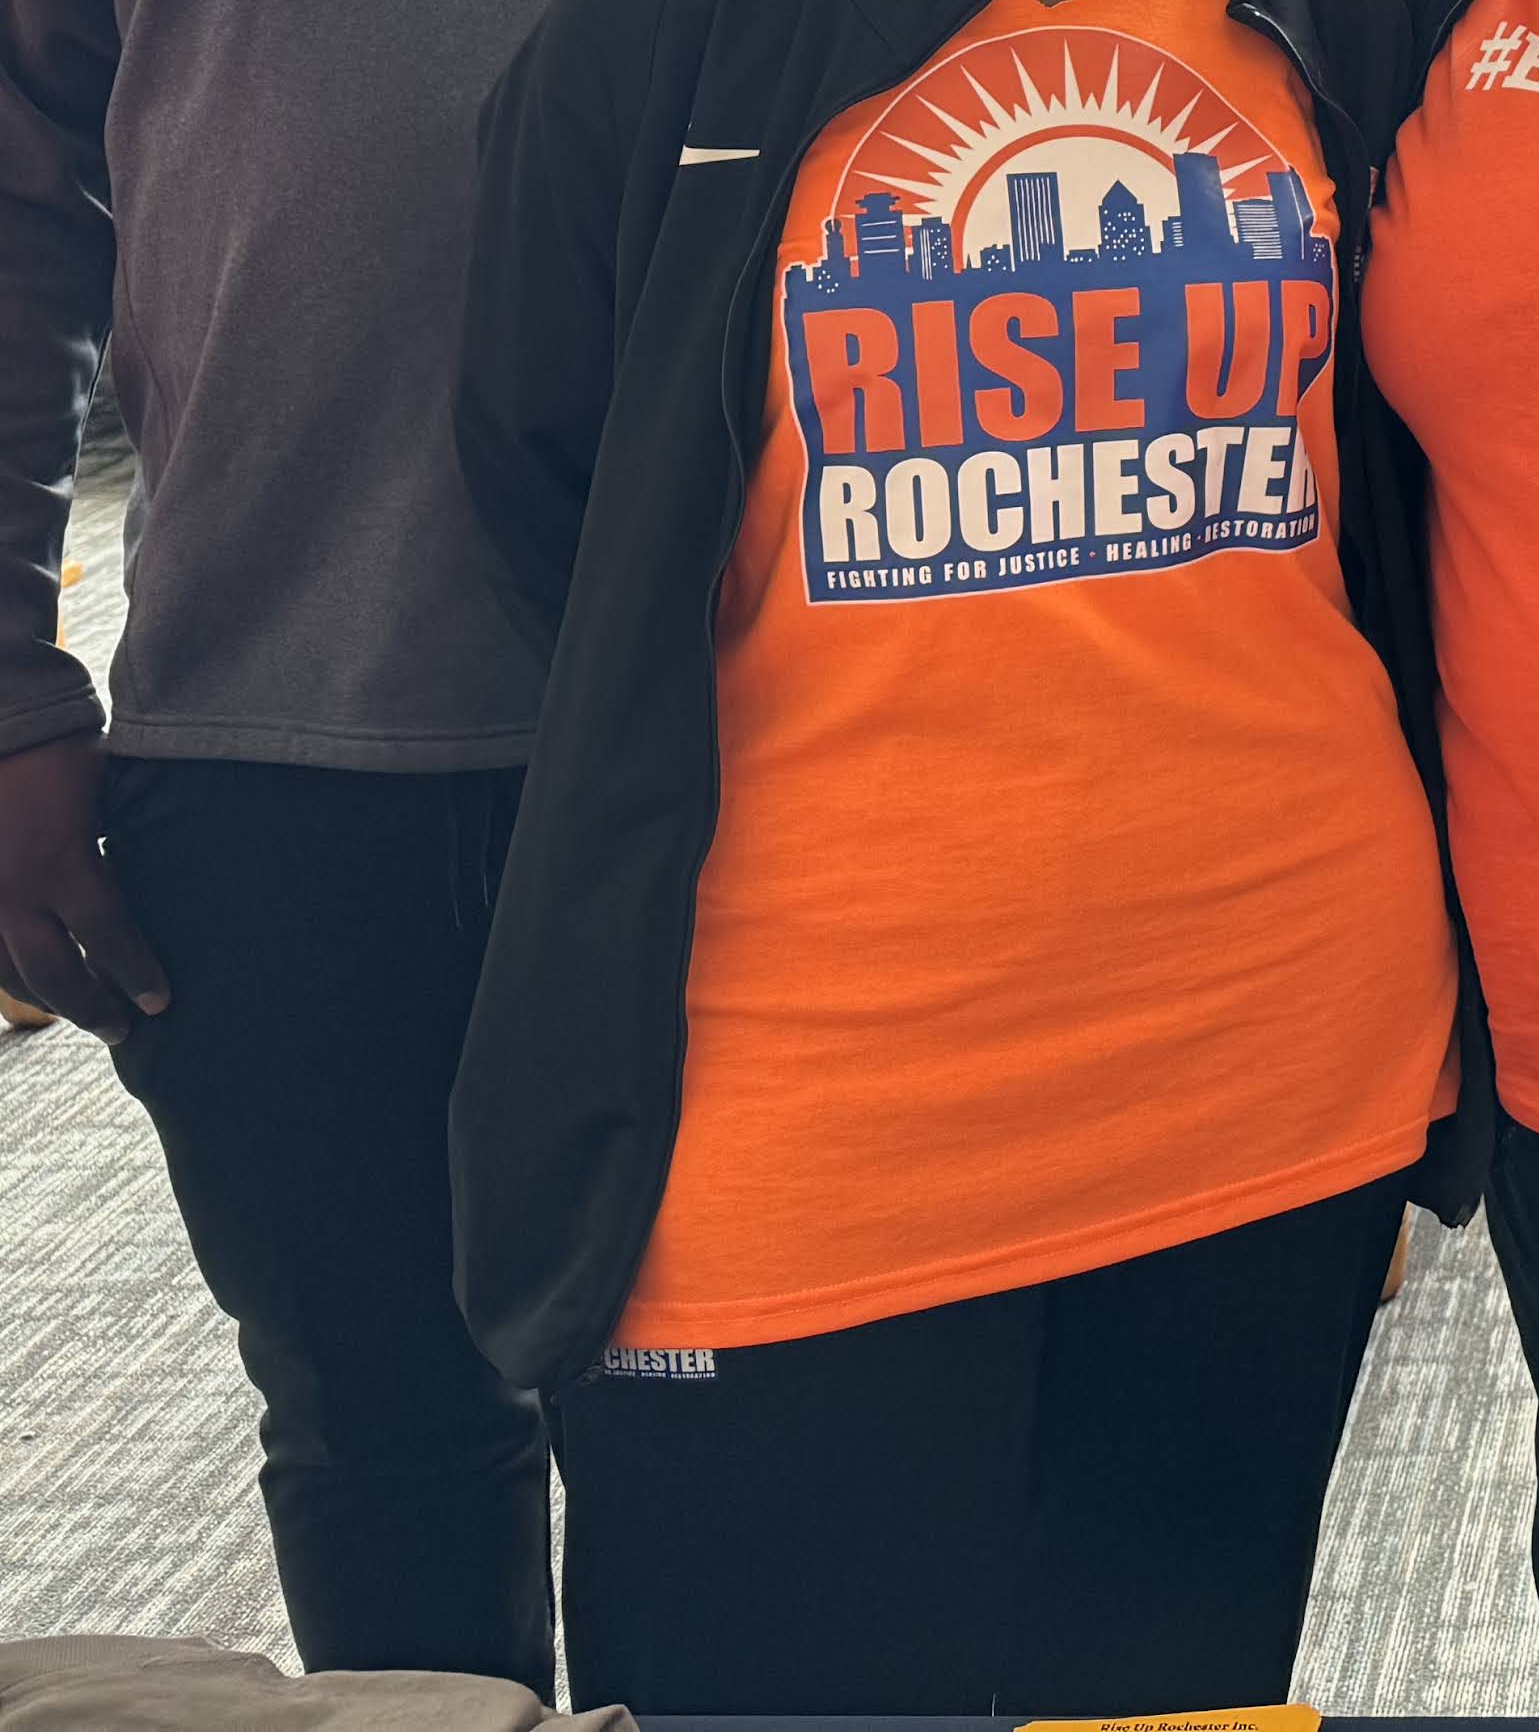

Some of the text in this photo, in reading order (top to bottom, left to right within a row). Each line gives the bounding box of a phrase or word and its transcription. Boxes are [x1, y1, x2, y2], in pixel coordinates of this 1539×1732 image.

[803, 280, 1331, 455] RISE UP
[819, 426, 1317, 562] ROCHESTER
[826, 565, 932, 589] FIGHTING
[944, 560, 987, 582] FOR
[998, 547, 1080, 576] JUSTICE
[1106, 532, 1193, 563] HEALING
